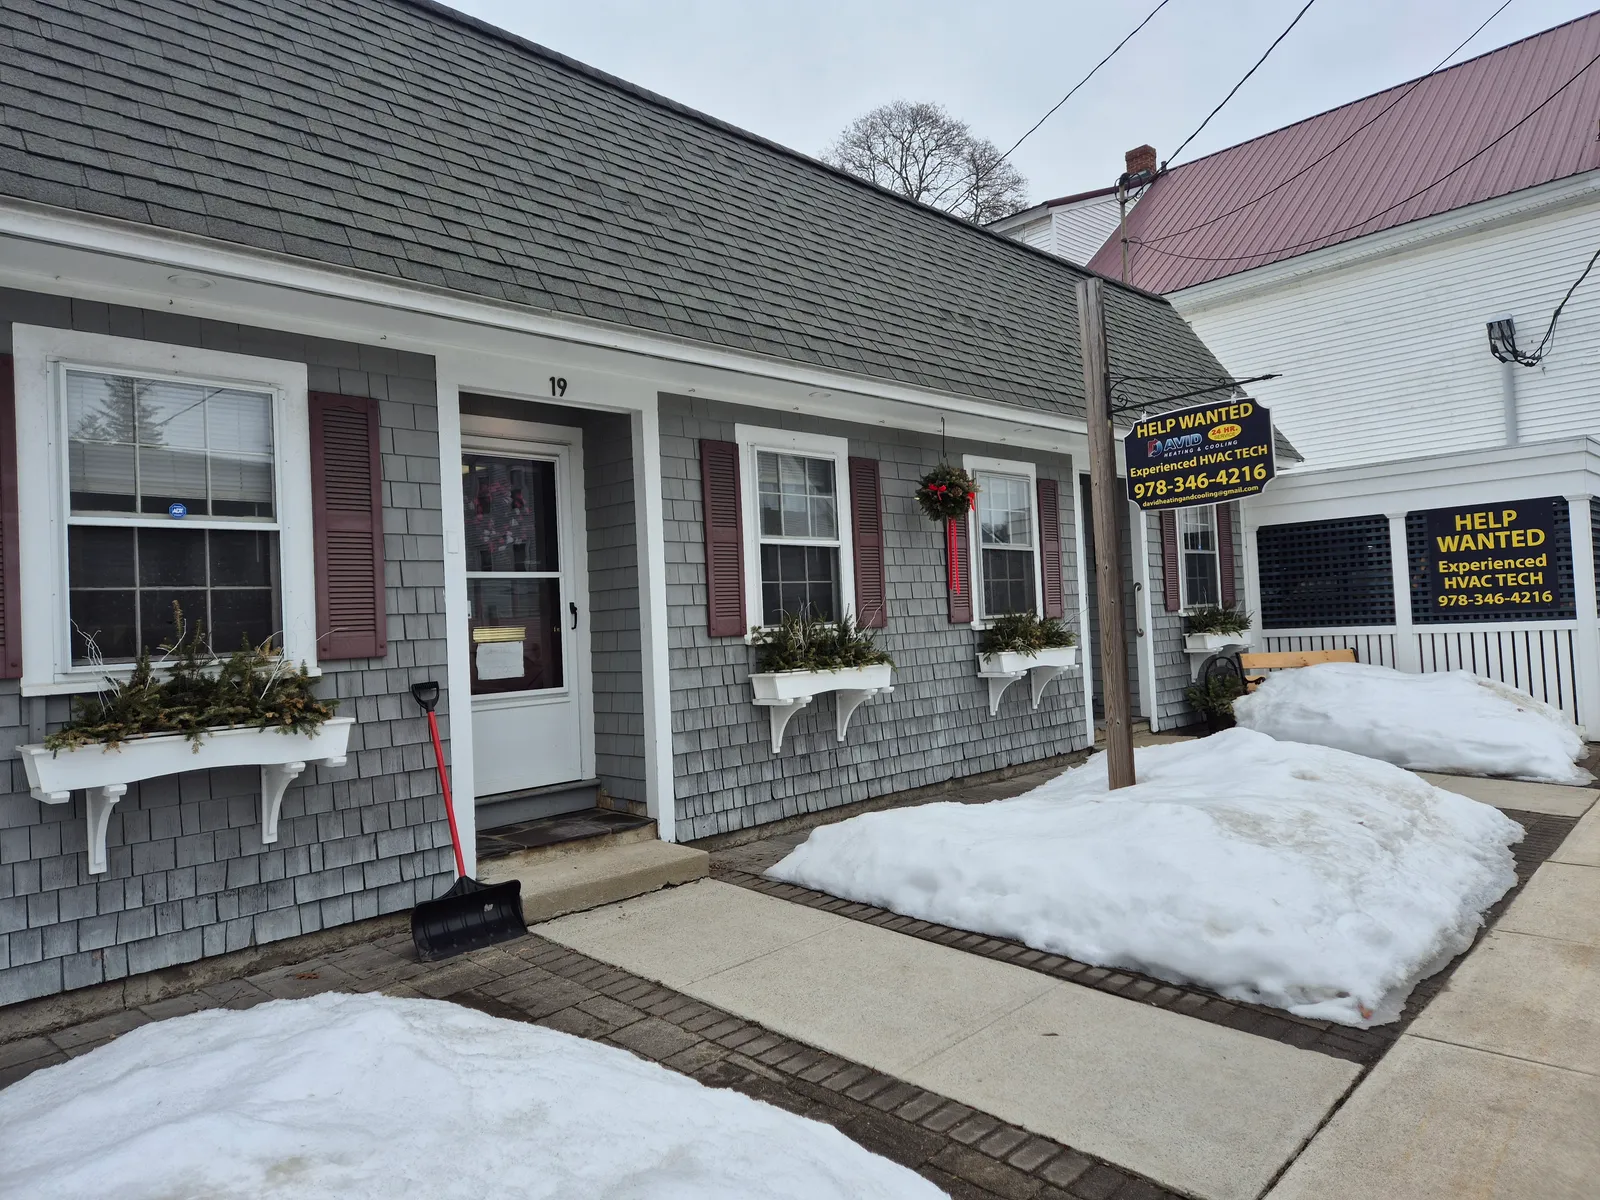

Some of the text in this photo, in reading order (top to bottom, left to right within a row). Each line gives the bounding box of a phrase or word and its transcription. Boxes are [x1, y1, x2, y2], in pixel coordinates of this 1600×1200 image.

[549, 376, 568, 398] 19
[1136, 402, 1254, 439] HELP WANTED
[1211, 425, 1238, 436] 24 HR.
[1147, 433, 1203, 458] DAVID
[1163, 448, 1195, 458] HEATING
[1204, 440, 1238, 450] COOLING
[1130, 444, 1268, 478] Experienced HVAC TECH
[1133, 463, 1267, 499] 978-346-4216
[1142, 485, 1259, 508] davidheatingandcooling@gmail.com
[1454, 509, 1518, 532] HELP
[1436, 528, 1546, 553] WANTED
[1438, 553, 1548, 576] Experienced
[1444, 571, 1544, 590] HVAC TECH
[1438, 590, 1553, 608] 978-346-4216
